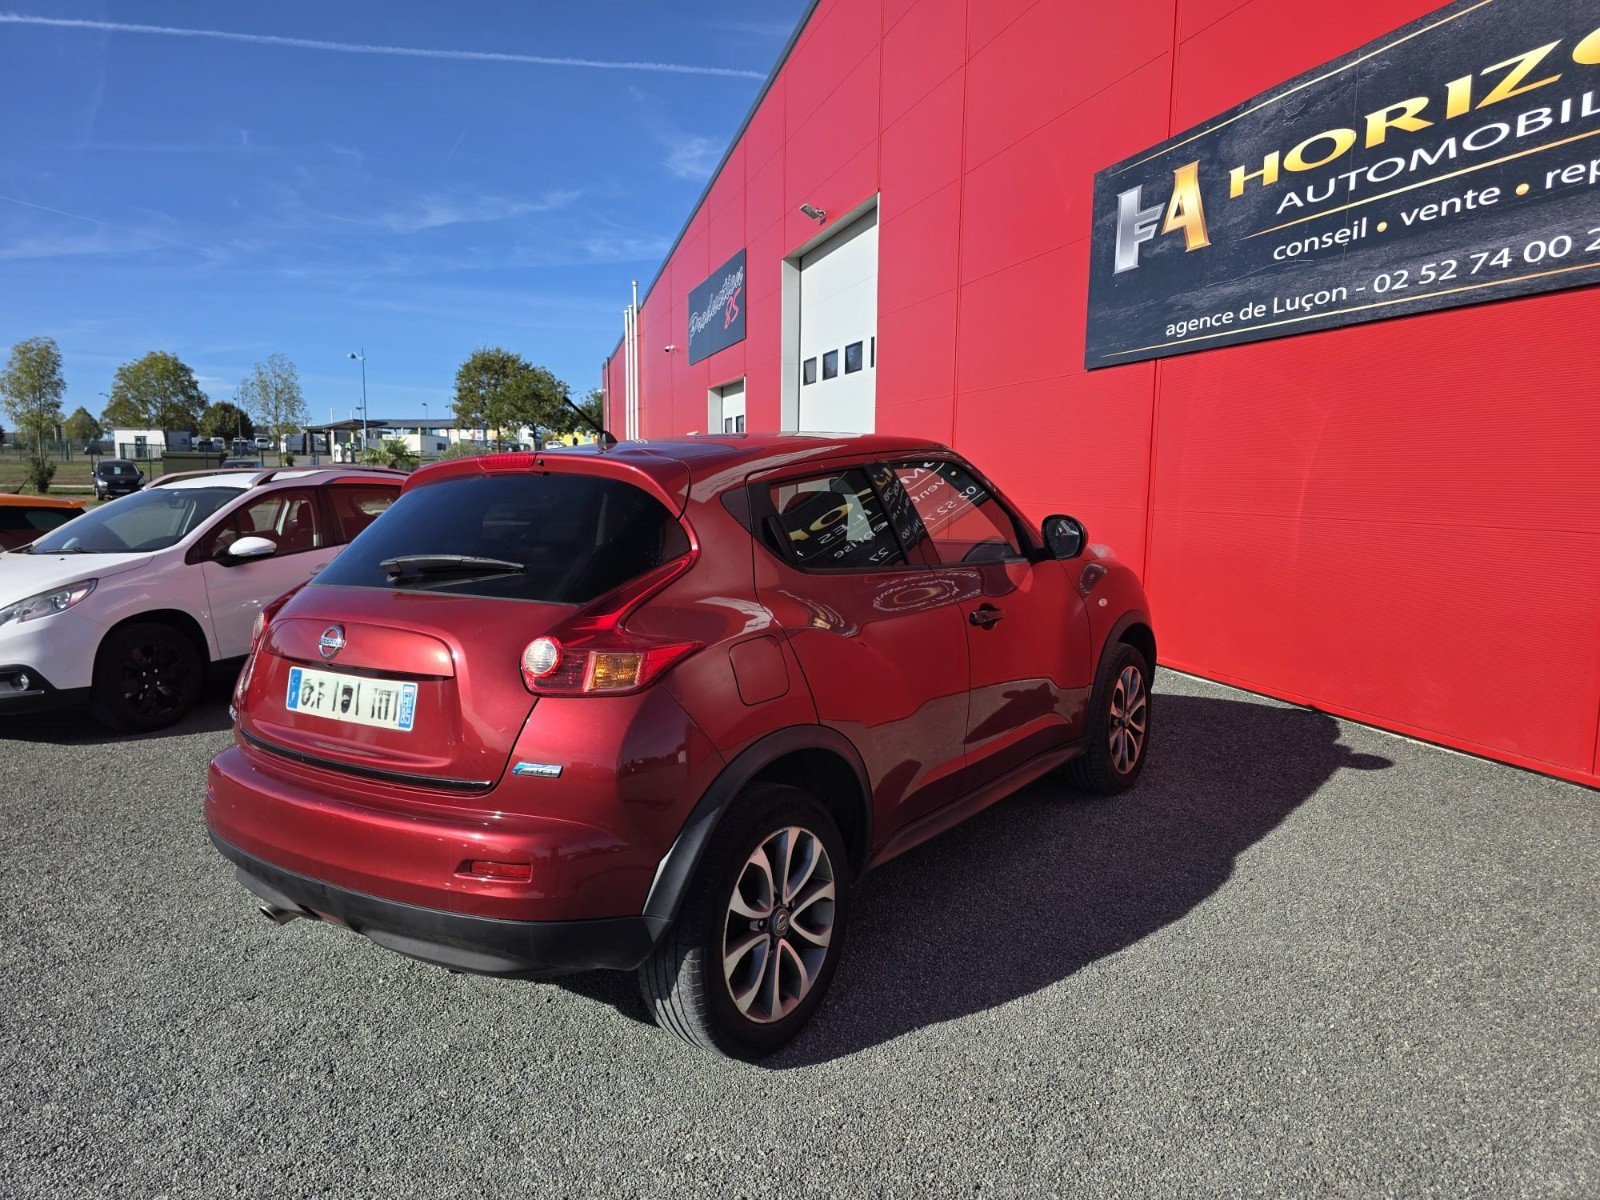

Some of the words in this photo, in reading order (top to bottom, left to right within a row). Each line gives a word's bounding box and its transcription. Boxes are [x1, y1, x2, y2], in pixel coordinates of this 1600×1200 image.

[1273, 217, 1367, 260] conseil
[1400, 187, 1500, 226] vente
[1165, 311, 1234, 338] agence
[1239, 302, 1266, 321] de
[1273, 286, 1347, 312] Luçon
[1373, 270, 1409, 293] 02
[1418, 260, 1457, 285] 52
[1470, 247, 1512, 275] 74
[1523, 235, 1572, 263] 00
